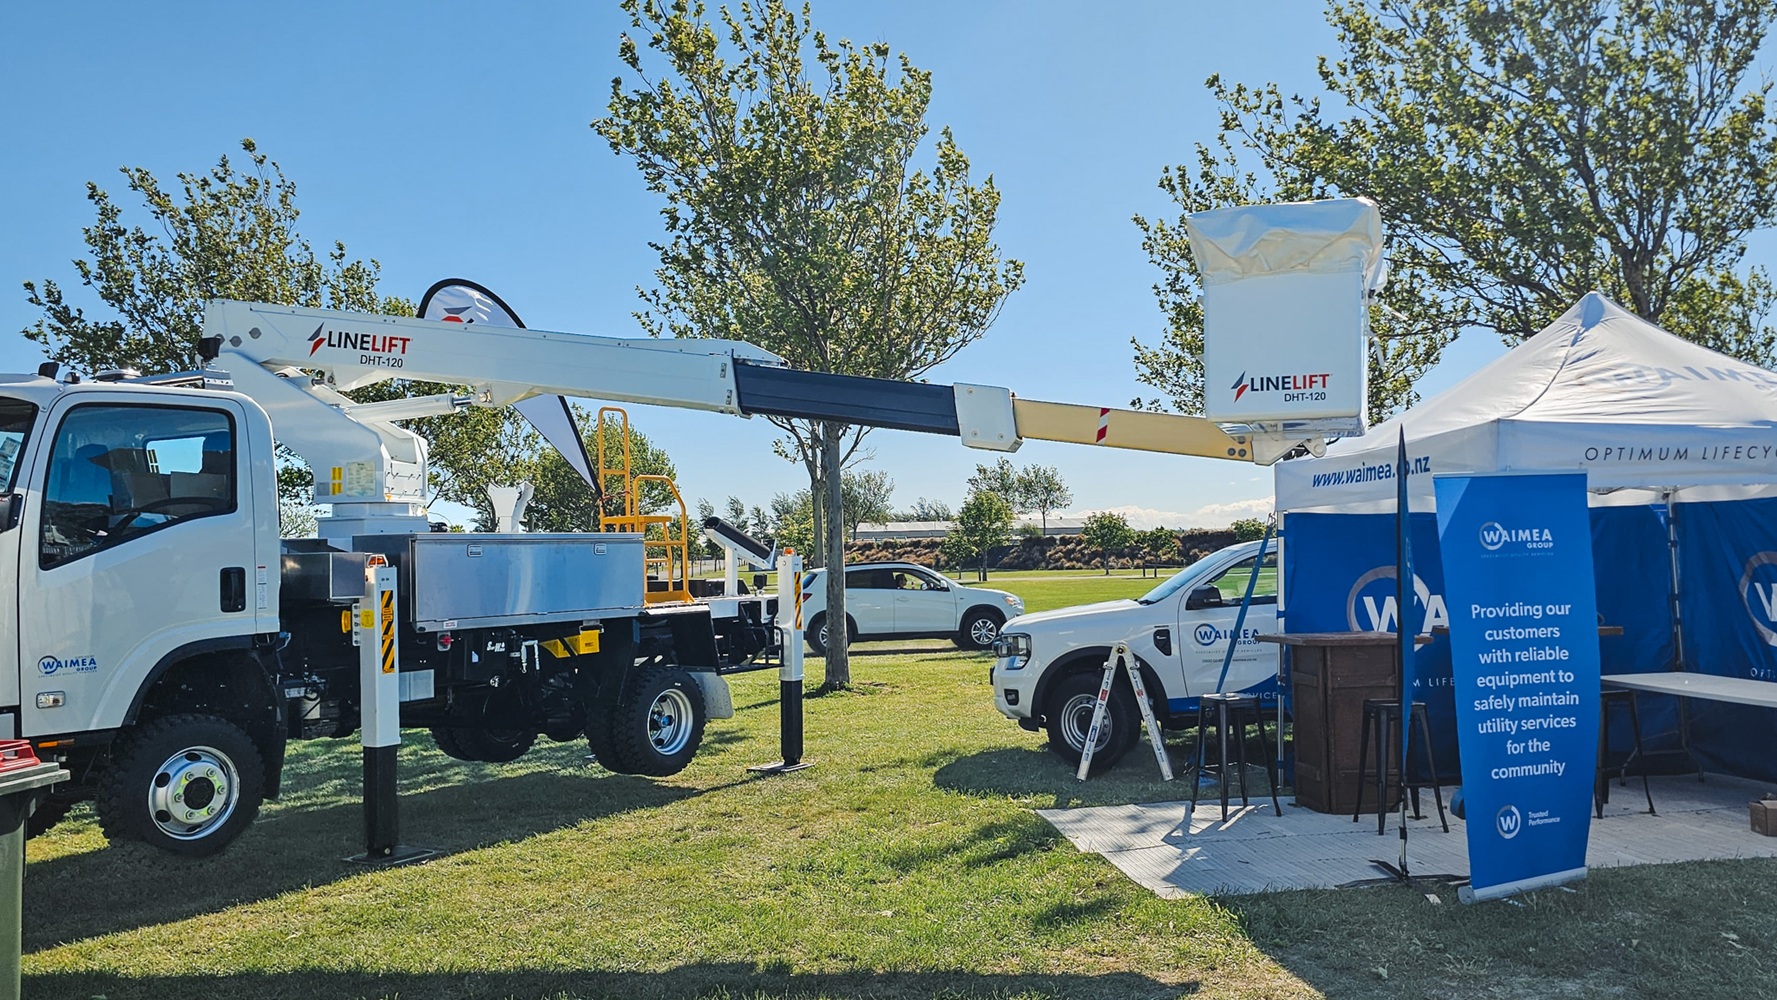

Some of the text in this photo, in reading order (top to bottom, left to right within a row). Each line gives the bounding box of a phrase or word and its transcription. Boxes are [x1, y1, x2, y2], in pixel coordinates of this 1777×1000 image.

[327, 330, 411, 354] LINELIFT
[360, 355, 403, 368] DHT-120
[1250, 374, 1330, 391] LINELIFT
[1284, 392, 1326, 402] DHT-120
[1585, 446, 1777, 461] OPTIMUM LIFECY
[1312, 456, 1431, 487] www.waimea..nz
[1483, 529, 1552, 543] WAIMEA
[1471, 602, 1571, 619] Providing our
[1198, 629, 1259, 640] WAIEA
[1485, 626, 1560, 641] customers
[42, 657, 97, 670] WAIMEA
[1478, 646, 1569, 664] with reliable
[1476, 670, 1574, 690] equipment to
[1474, 691, 1579, 712] safely maintain
[1478, 714, 1577, 735] utility services
[1506, 738, 1551, 755] for the
[1491, 760, 1566, 780] community
[1528, 809, 1549, 819] Trusted
[1528, 817, 1561, 827] Performance
